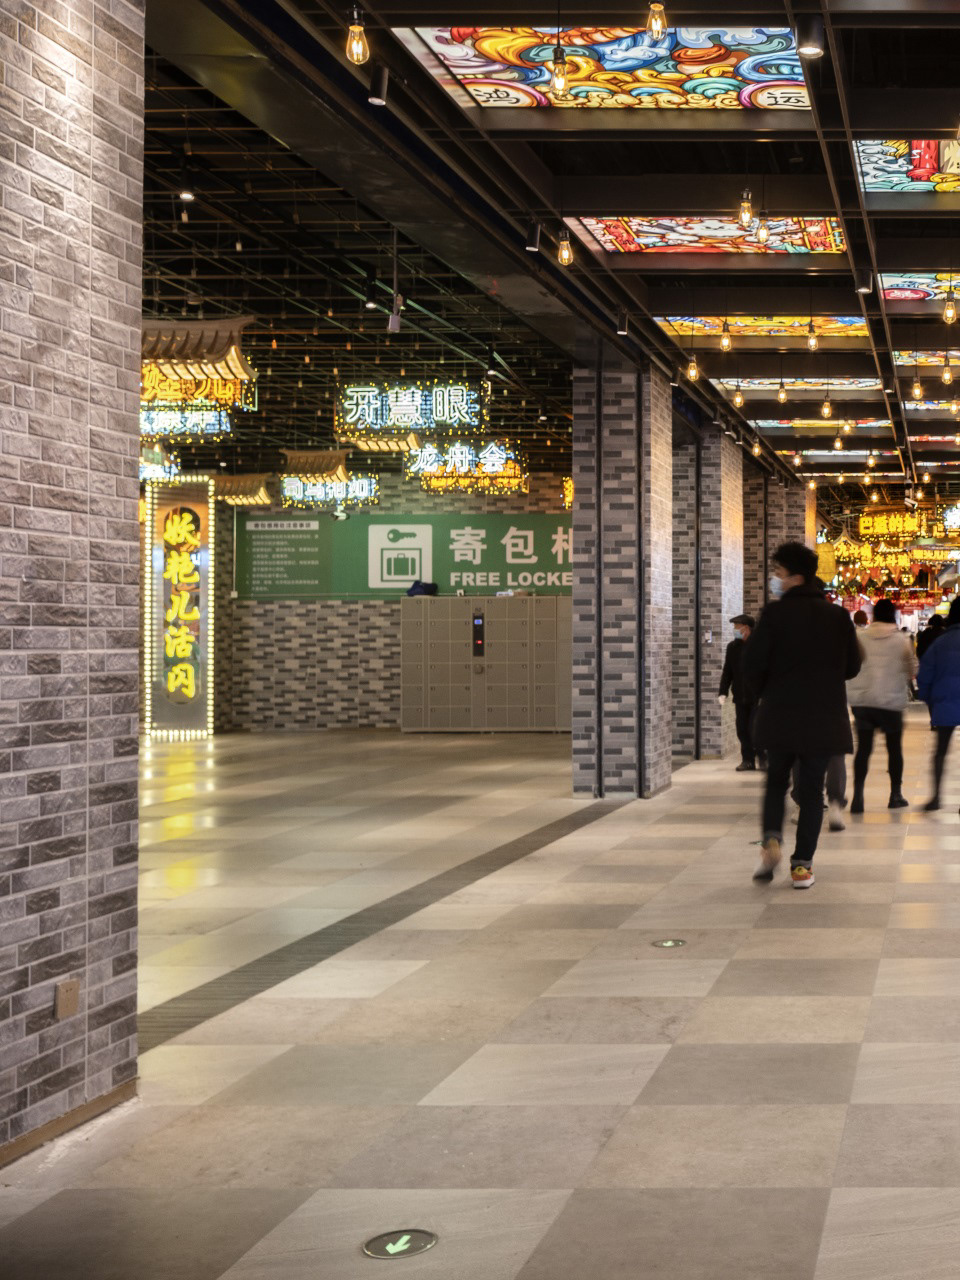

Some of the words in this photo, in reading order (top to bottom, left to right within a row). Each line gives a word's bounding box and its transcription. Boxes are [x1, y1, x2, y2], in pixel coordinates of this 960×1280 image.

[409, 442, 507, 473] 龙舟会
[450, 572, 501, 587] FREE
